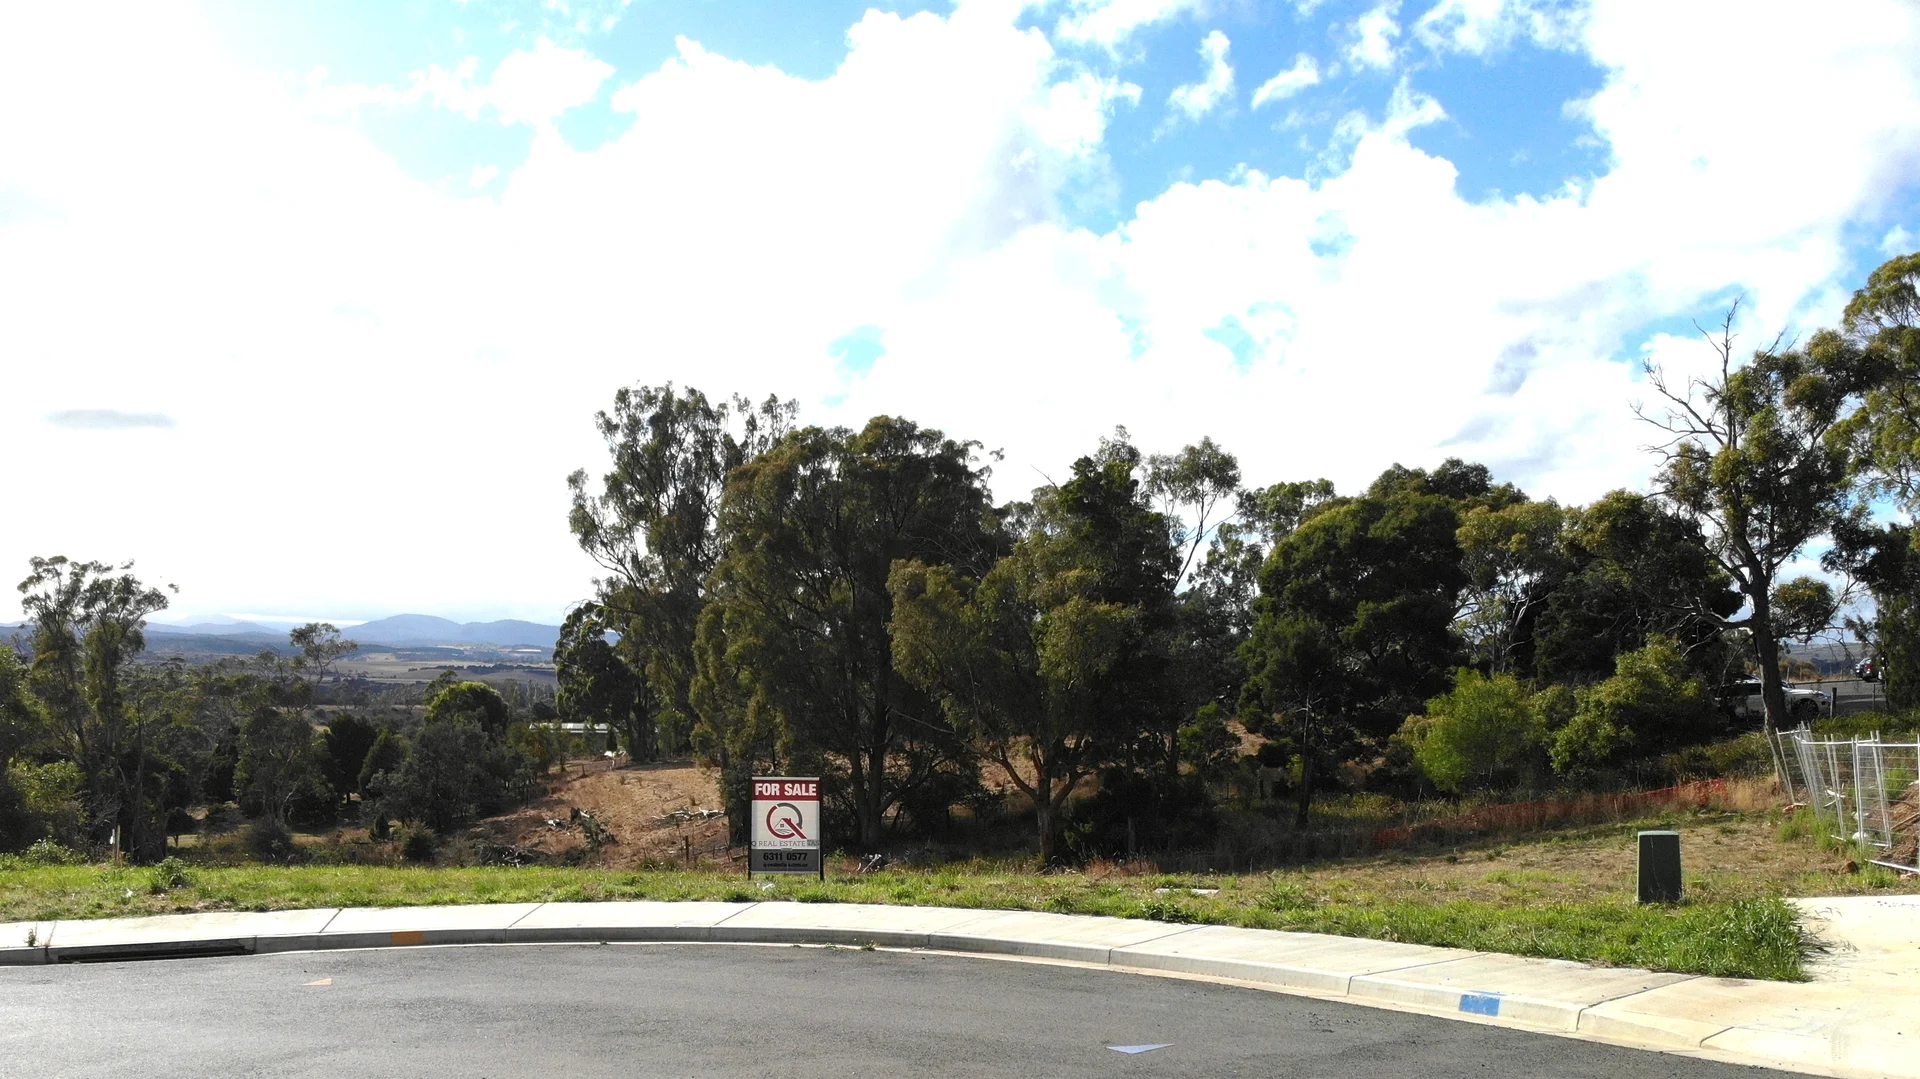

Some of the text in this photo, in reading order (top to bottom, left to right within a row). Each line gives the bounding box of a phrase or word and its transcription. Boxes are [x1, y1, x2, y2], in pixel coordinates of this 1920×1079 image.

[755, 783, 817, 796] FOR SALE
[763, 852, 808, 861] 6311 0577
